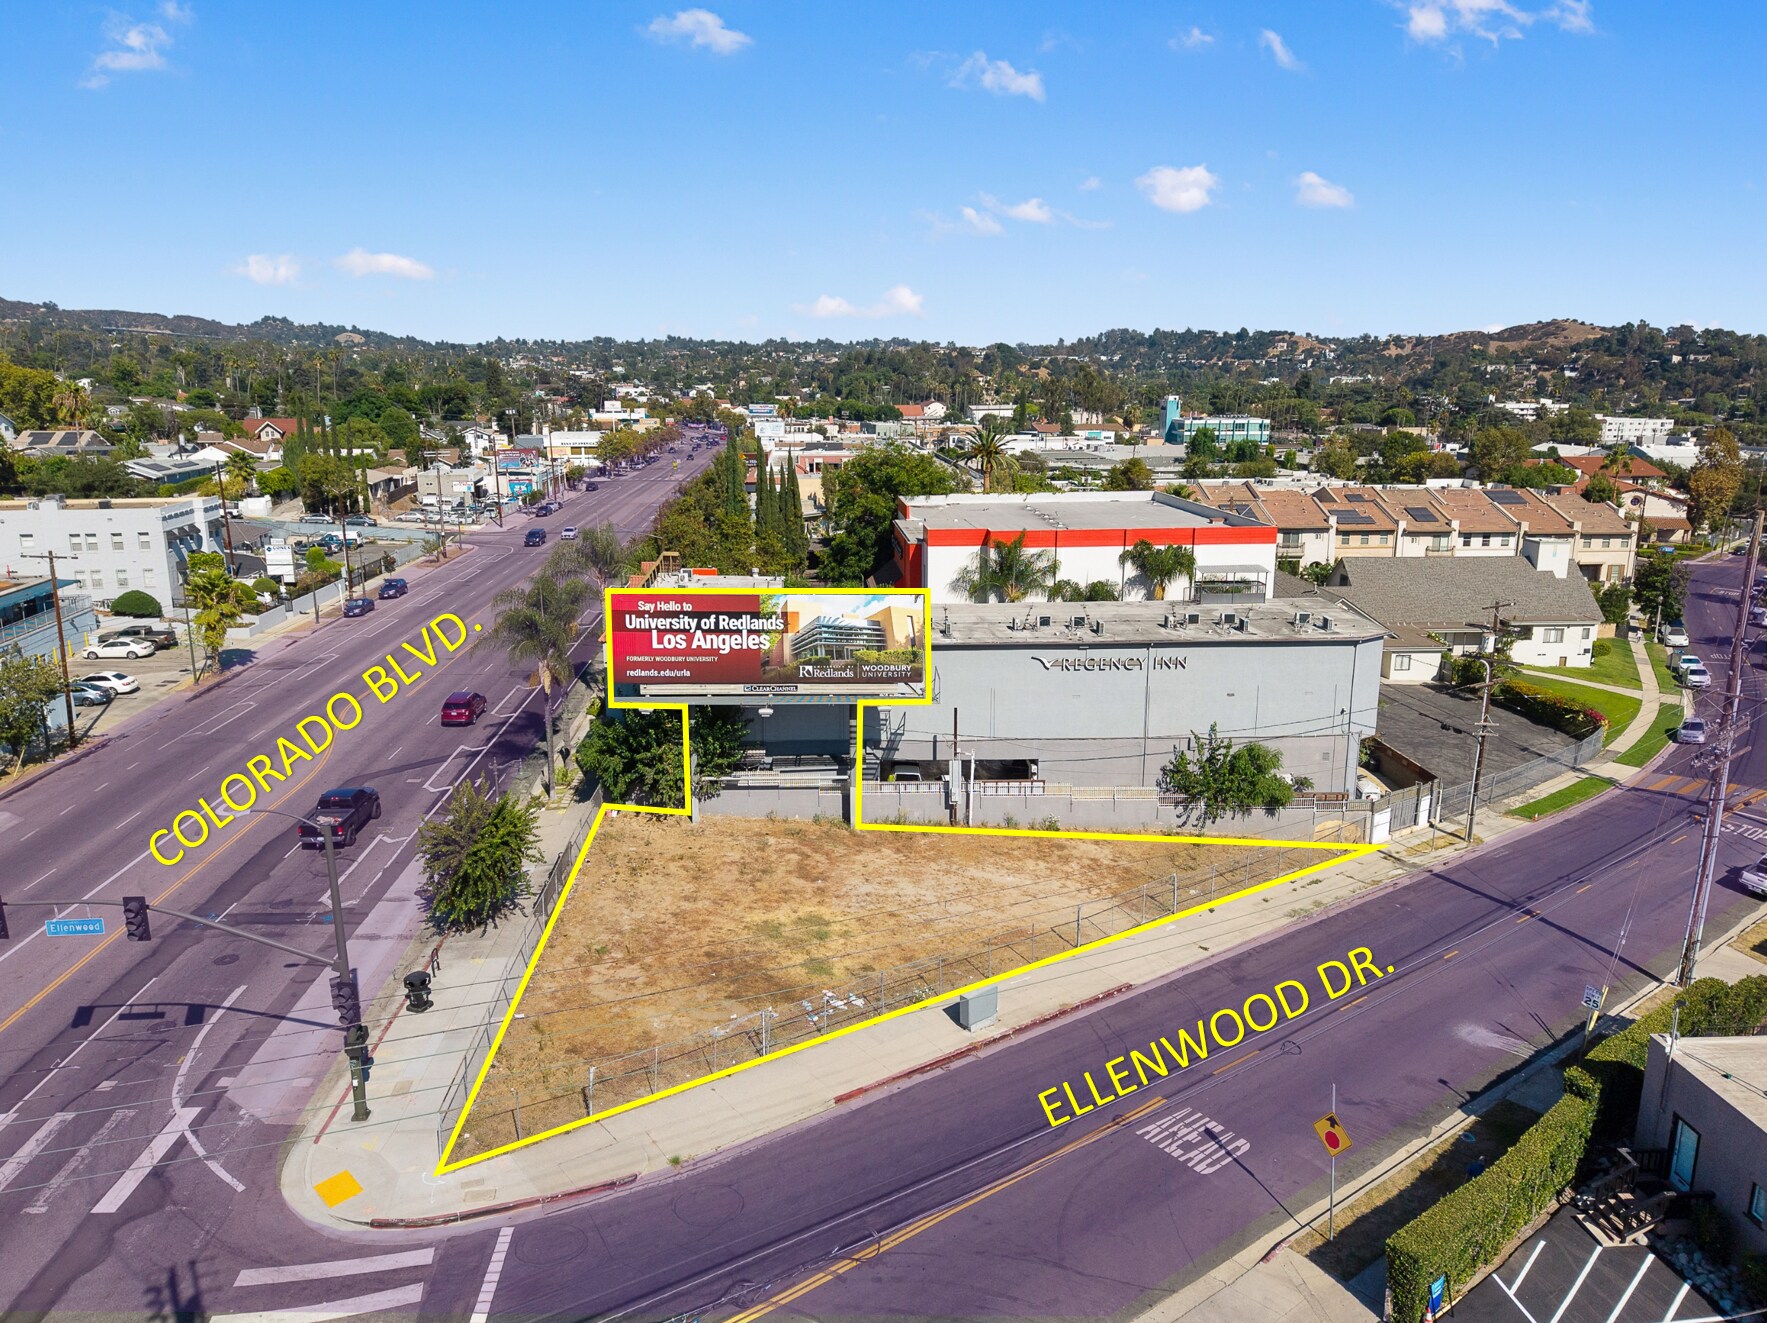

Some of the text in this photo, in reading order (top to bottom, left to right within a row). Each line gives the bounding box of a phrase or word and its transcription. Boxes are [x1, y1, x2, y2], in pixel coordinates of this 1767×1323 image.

[637, 600, 692, 613] Say Hello to
[625, 614, 784, 633] University of Redlands
[651, 630, 770, 654] Los Angeles
[861, 664, 911, 672] WOODBURY
[1061, 656, 1188, 671] REGENCY INN
[626, 669, 691, 678] redlands.edu/urla
[813, 668, 854, 678] Redlands
[50, 922, 100, 933] Ellenwood
[1584, 996, 1599, 1009] 25
[1135, 1107, 1251, 1175] AHEAD
